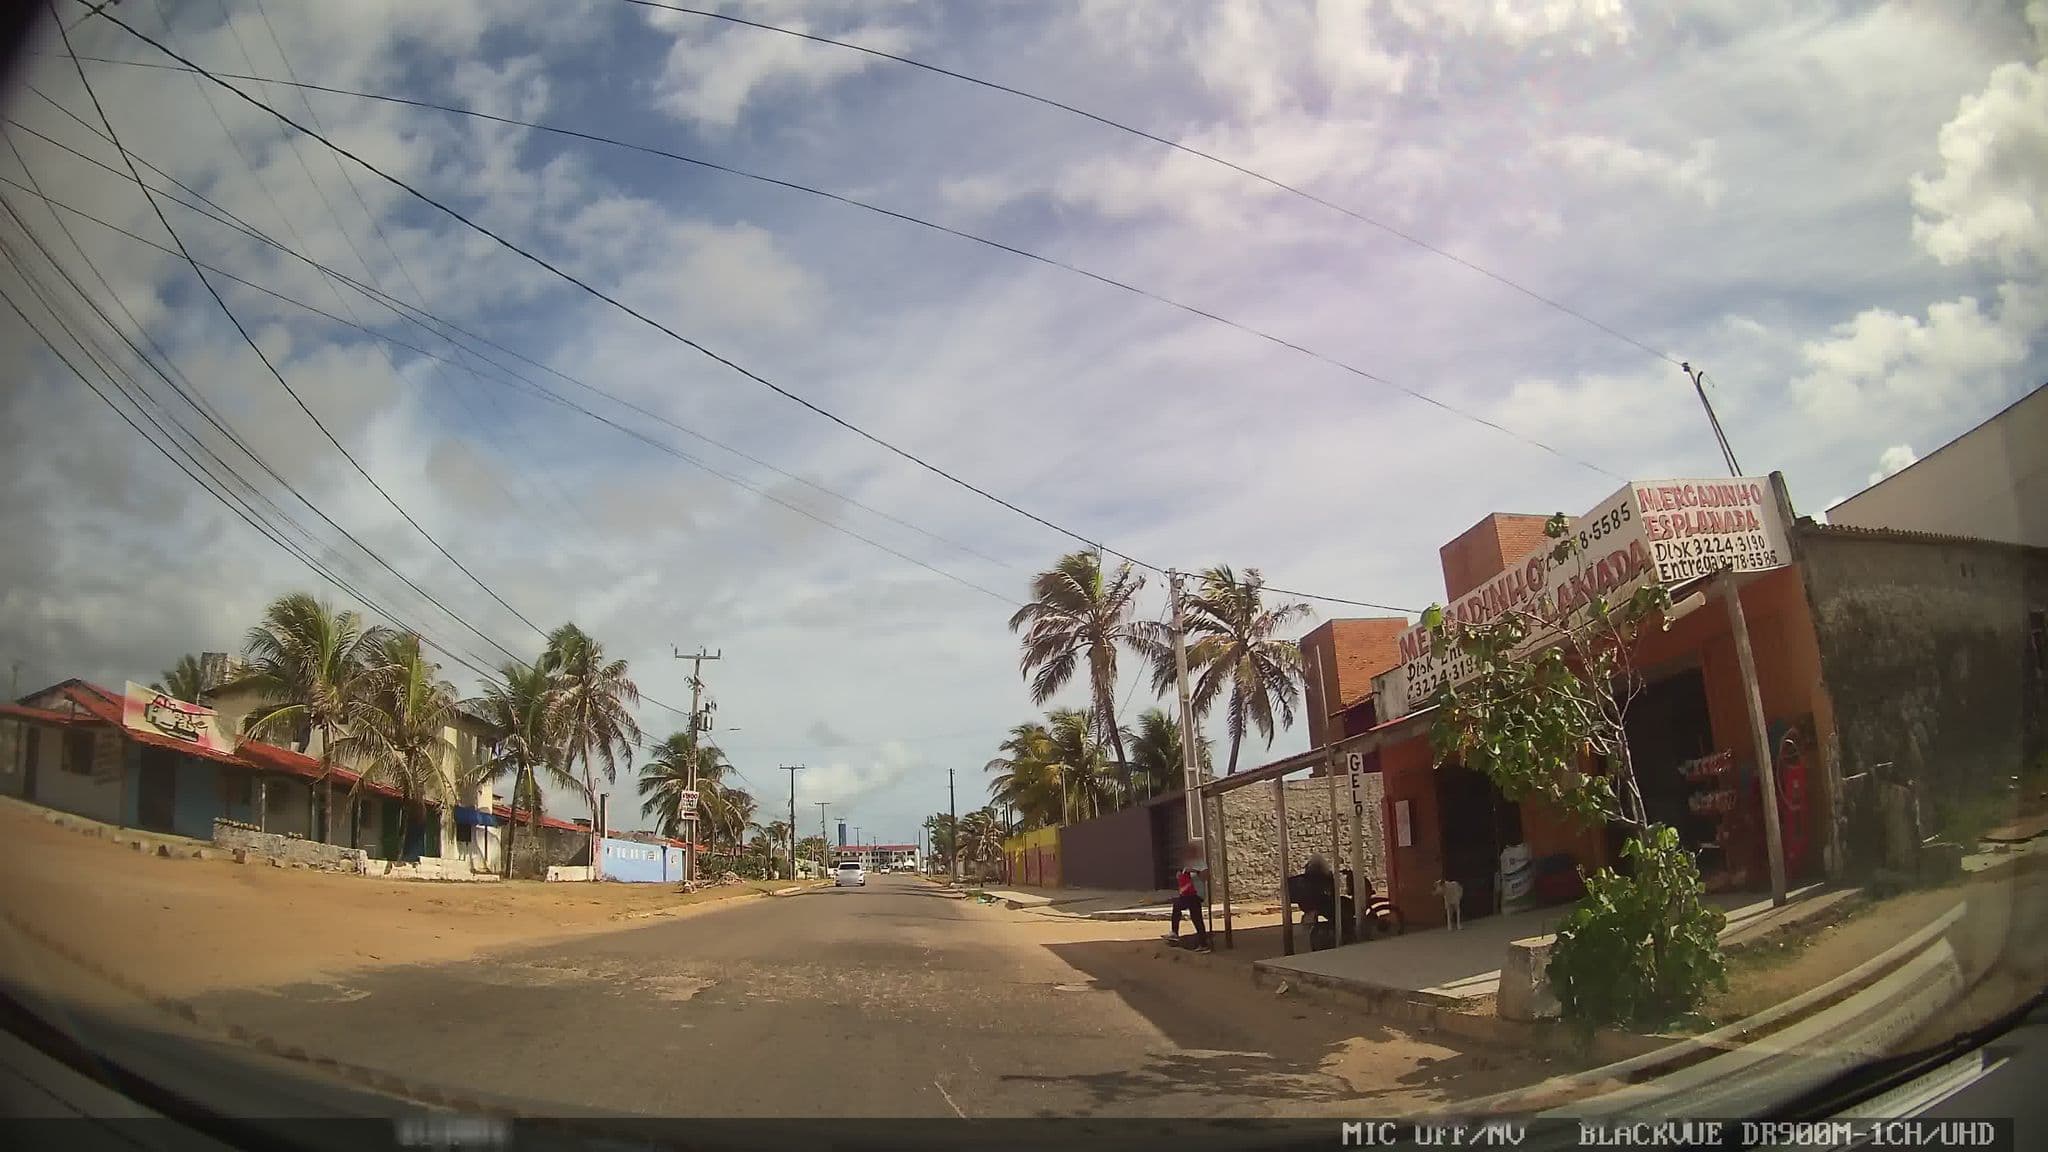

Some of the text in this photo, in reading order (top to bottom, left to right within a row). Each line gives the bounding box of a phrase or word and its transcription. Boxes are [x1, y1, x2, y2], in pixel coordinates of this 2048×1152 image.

[1637, 484, 1762, 513] MERCADINHO
[1643, 509, 1761, 541] ESPLANADA
[1655, 541, 1693, 562] Disk
[1658, 556, 1719, 580] Entrega
[1407, 654, 1434, 683] Disk
[1350, 754, 1363, 817] GELO
